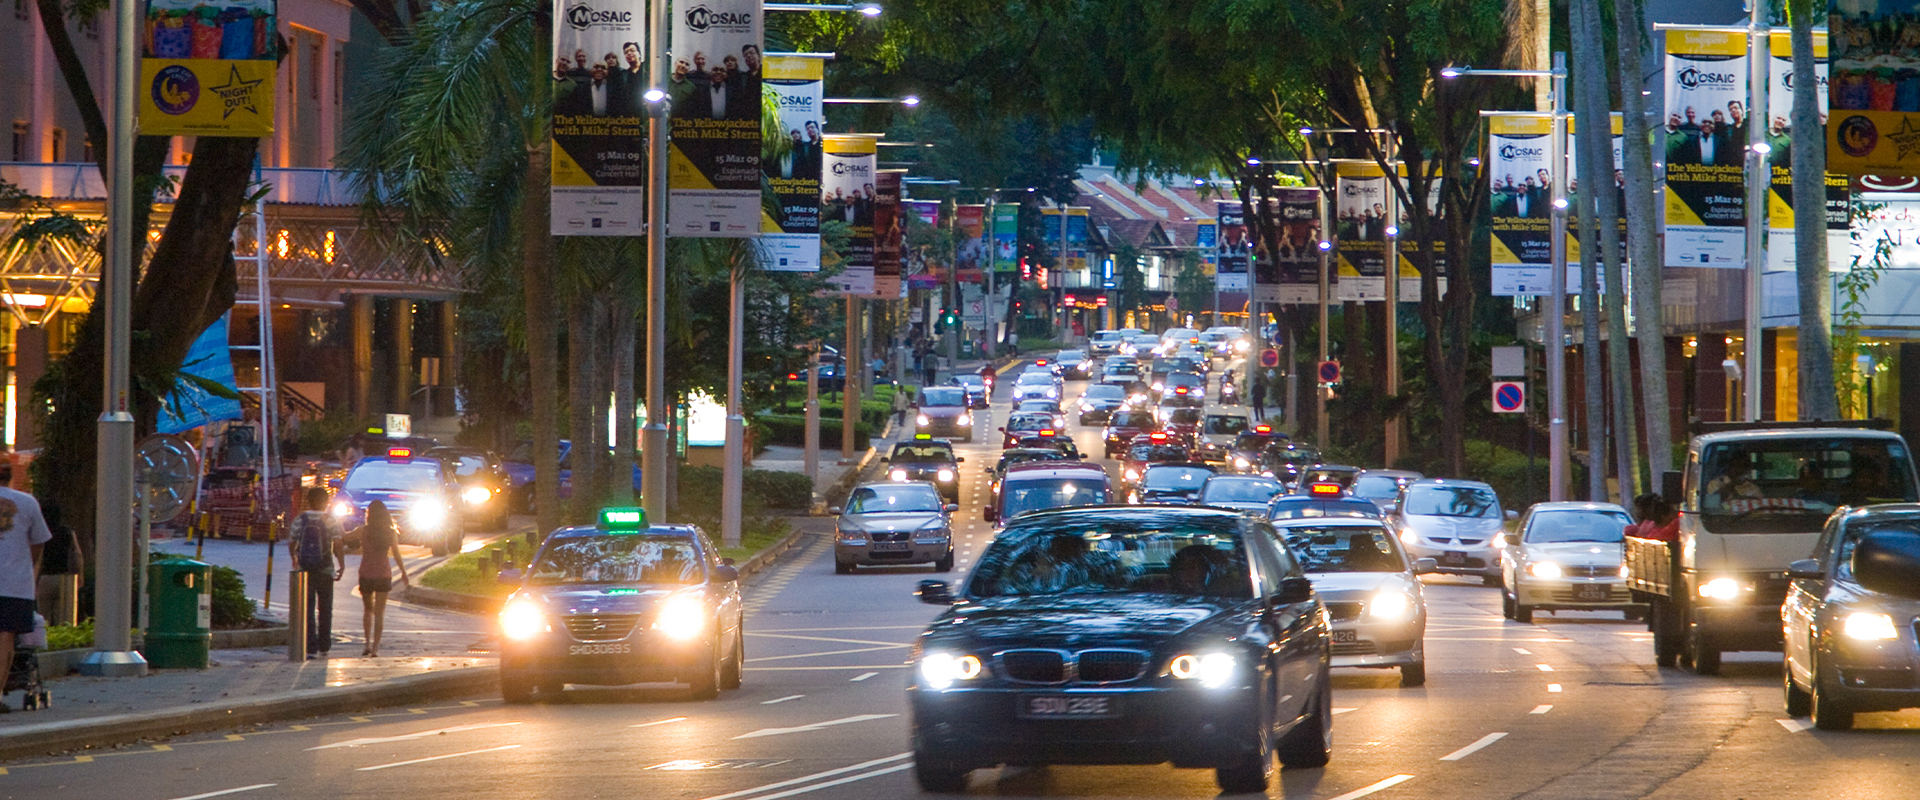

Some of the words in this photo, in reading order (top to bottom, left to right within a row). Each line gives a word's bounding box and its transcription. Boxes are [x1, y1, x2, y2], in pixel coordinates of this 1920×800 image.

[573, 9, 632, 24] MOSAIC
[693, 11, 751, 25] MOSAIC
[1684, 71, 1735, 84] MOSAIC
[219, 86, 254, 99] NIGHT
[225, 97, 252, 108] OUT!
[780, 96, 813, 107] OSAIC
[554, 115, 574, 125] The
[575, 115, 640, 127] Yellowjackets
[674, 118, 693, 128] The
[694, 118, 760, 130] Yellowjackets
[555, 125, 581, 136] with
[582, 125, 610, 136] Mike
[612, 126, 640, 136] Stern
[673, 129, 699, 139] with
[701, 129, 729, 139] Mike
[731, 129, 760, 139] Stern
[597, 152, 606, 160] 15
[607, 151, 626, 160] Mar
[627, 152, 640, 161] 09
[726, 154, 745, 164] Mar
[746, 156, 759, 164] 09
[834, 164, 869, 173] MOSAIC
[1667, 163, 1685, 172] The
[1686, 163, 1744, 175] Yellowjackets
[1772, 166, 1789, 175] The
[1667, 173, 1690, 182] with
[1691, 173, 1717, 182] Mike
[1718, 174, 1743, 183] Stern
[1772, 175, 1792, 184] with
[796, 186, 819, 195] Stern
[1705, 196, 1713, 204] 15
[1715, 195, 1731, 204] Mar
[1732, 197, 1743, 205] 09
[1837, 200, 1848, 208] 09
[792, 205, 807, 213] Mar
[1506, 216, 1550, 225] Yellowjackets
[1331, 631, 1355, 643] 42G
